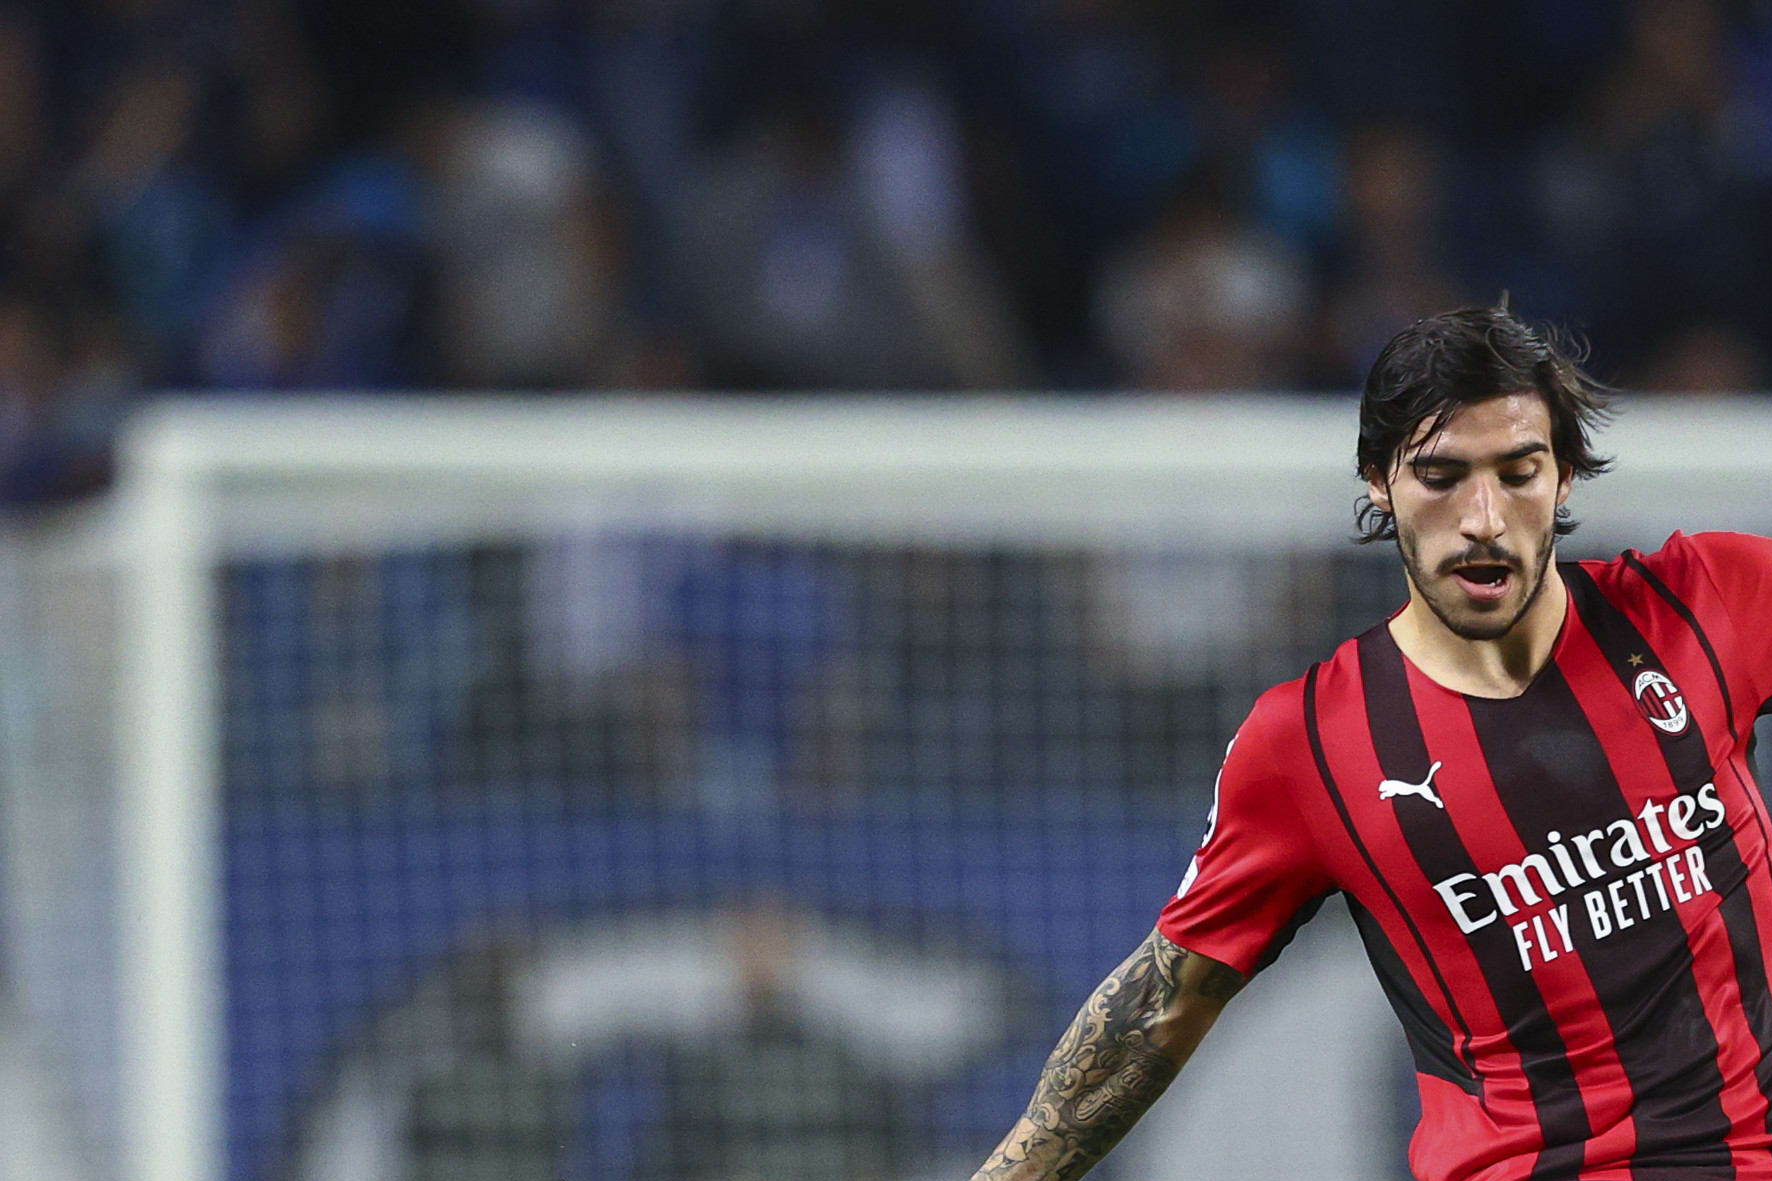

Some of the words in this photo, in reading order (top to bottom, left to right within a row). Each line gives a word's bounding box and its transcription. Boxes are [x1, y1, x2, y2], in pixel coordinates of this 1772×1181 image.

[1433, 782, 1725, 935] Emirates
[1512, 903, 1575, 972] FLY
[1583, 846, 1713, 940] BETTER
